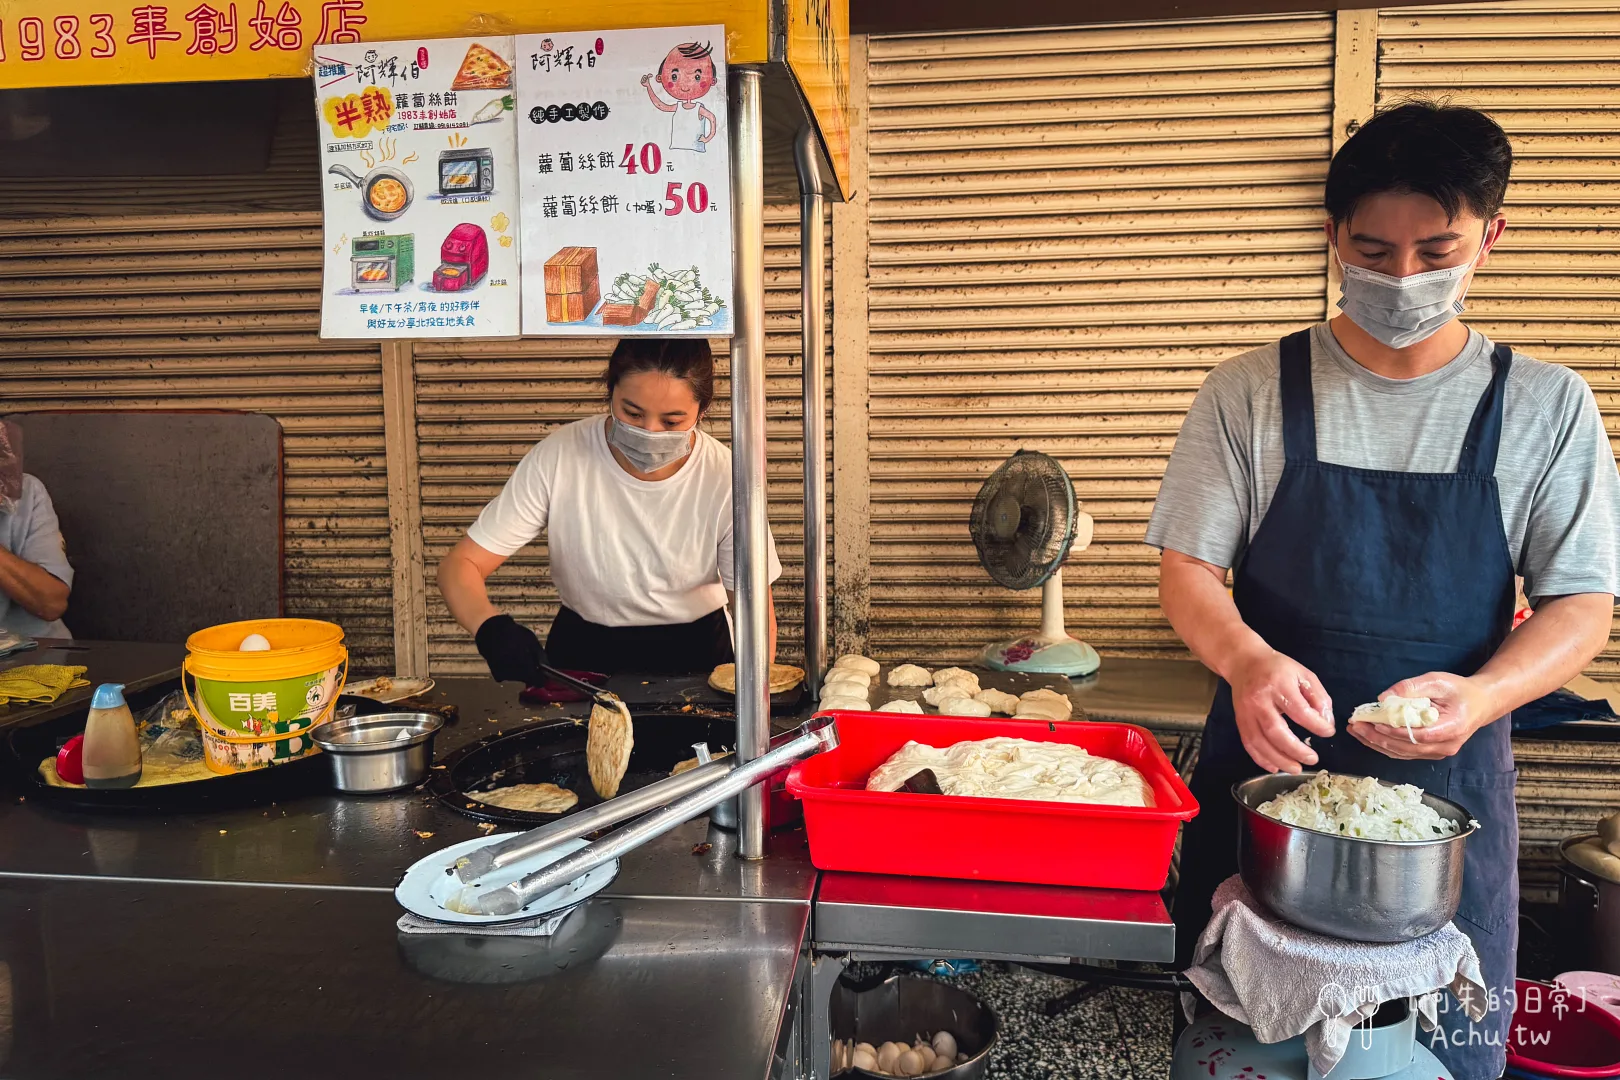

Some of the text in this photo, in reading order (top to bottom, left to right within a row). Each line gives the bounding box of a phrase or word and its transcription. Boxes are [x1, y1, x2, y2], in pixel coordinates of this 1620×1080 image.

[355, 56, 420, 88] 阿輝伯
[531, 45, 597, 73] 阿輝伯
[335, 90, 391, 131] 半熟
[531, 102, 607, 123] 純手工製作
[618, 142, 662, 175] 40
[664, 181, 709, 216] 50
[367, 315, 476, 330] 與好友分享北投在地美食
[228, 691, 277, 712] 百美
